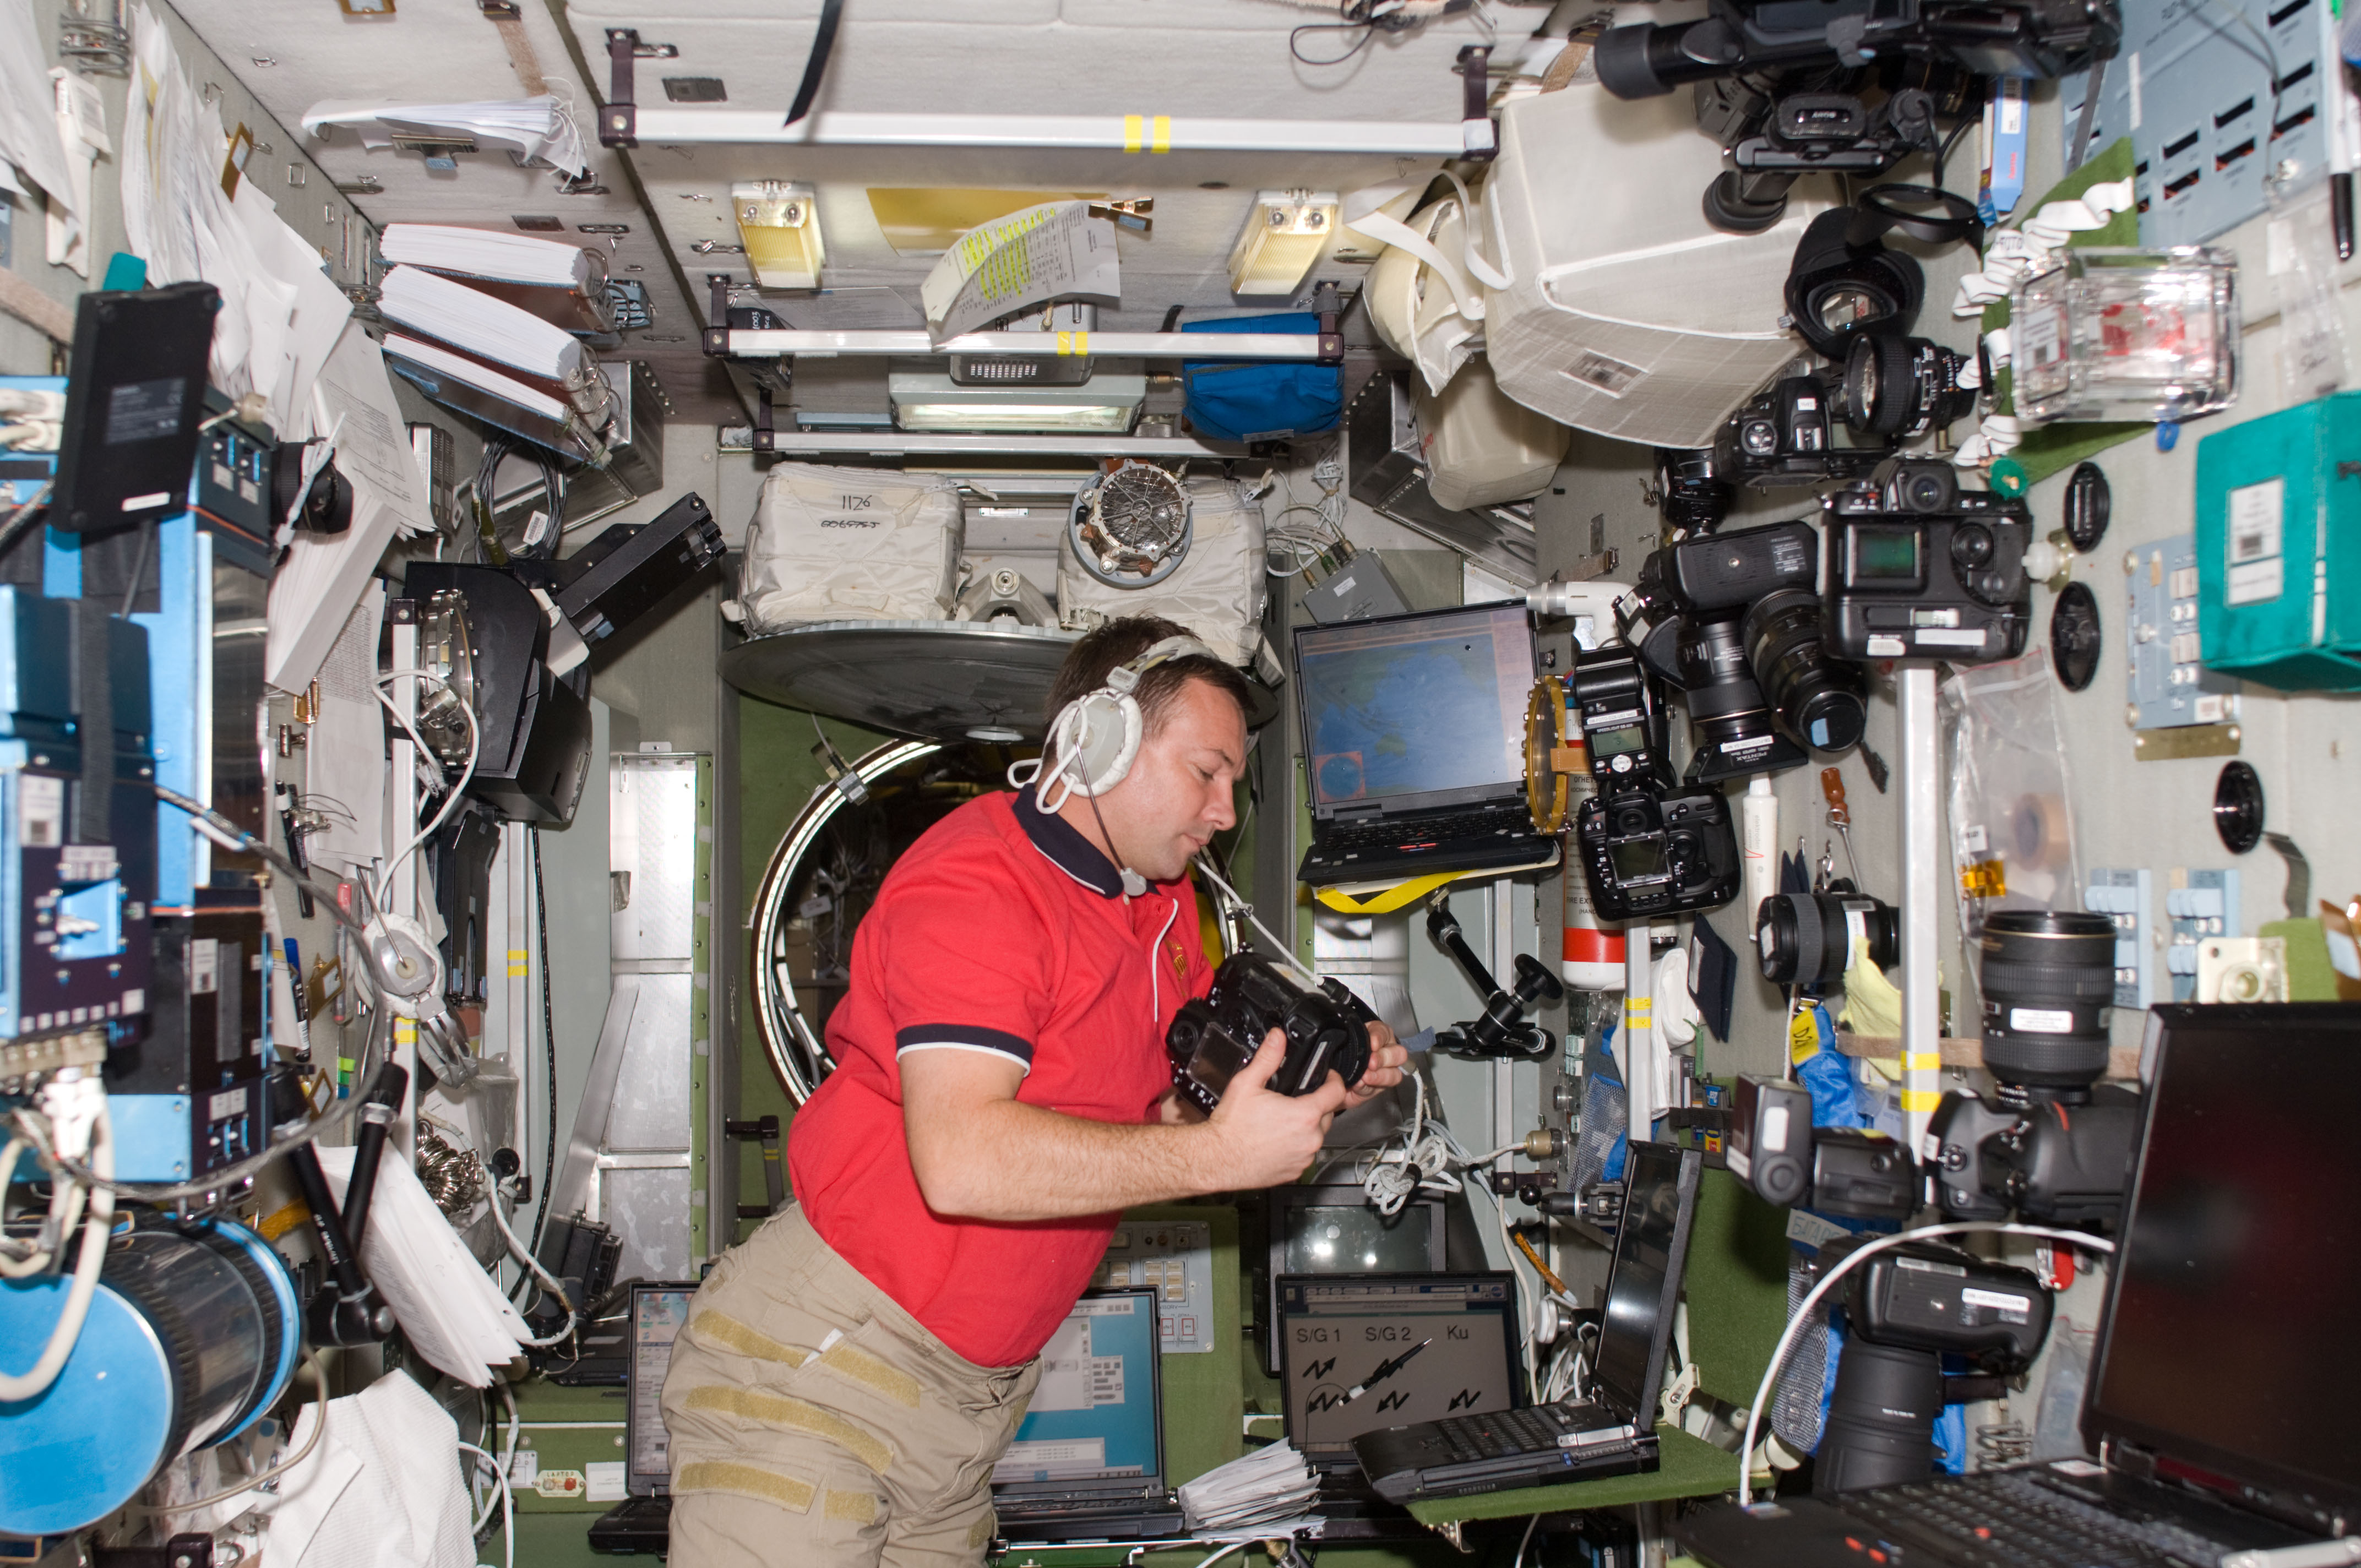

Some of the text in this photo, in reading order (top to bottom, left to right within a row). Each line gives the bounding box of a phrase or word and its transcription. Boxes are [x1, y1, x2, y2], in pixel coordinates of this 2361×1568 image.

[842, 495, 873, 511] 1126
[1736, 752, 1767, 761] PENTAX
[1297, 1328, 1340, 1343] S/G 1
[1365, 1326, 1411, 1342] S/G 2
[1447, 1325, 1469, 1340] Ku
